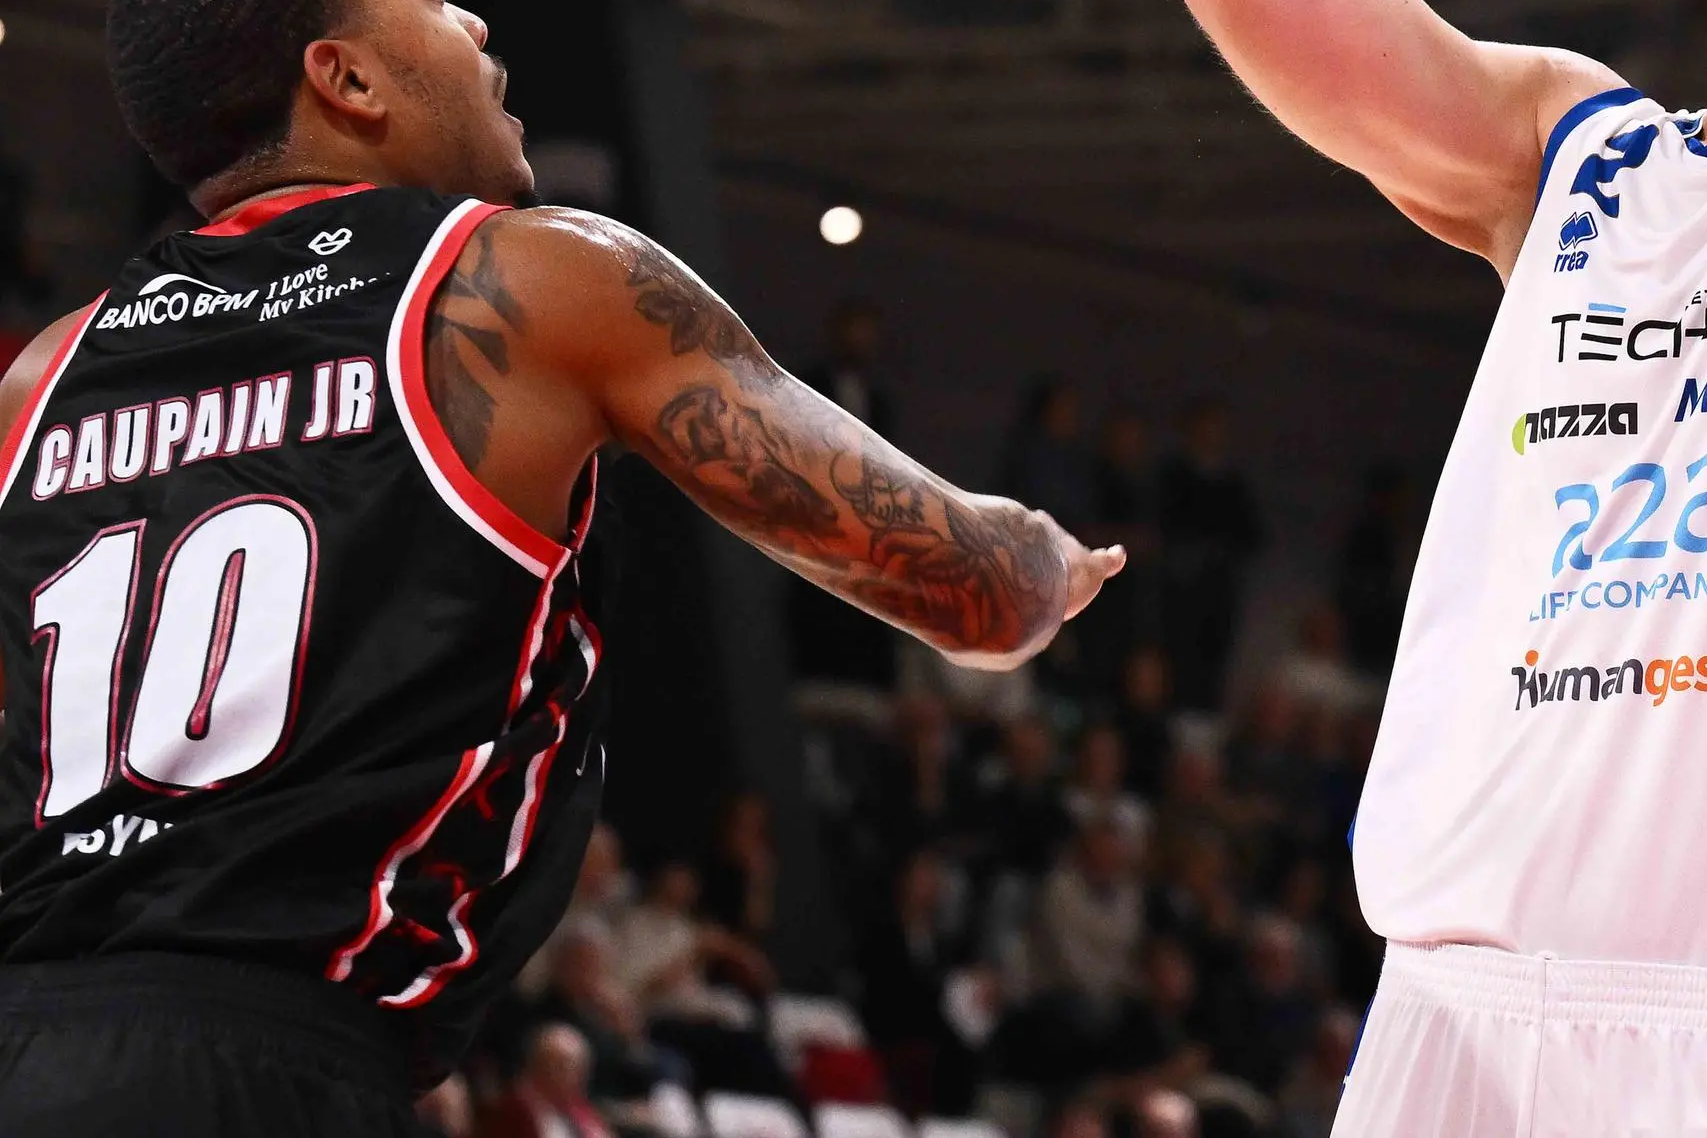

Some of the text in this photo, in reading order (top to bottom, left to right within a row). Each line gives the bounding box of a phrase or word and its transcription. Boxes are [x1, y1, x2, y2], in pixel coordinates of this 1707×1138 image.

[96, 288, 260, 330] BANCO BPM
[266, 263, 329, 300] I Love
[31, 355, 378, 502] CAUPAIN JR
[30, 493, 319, 830] 10
